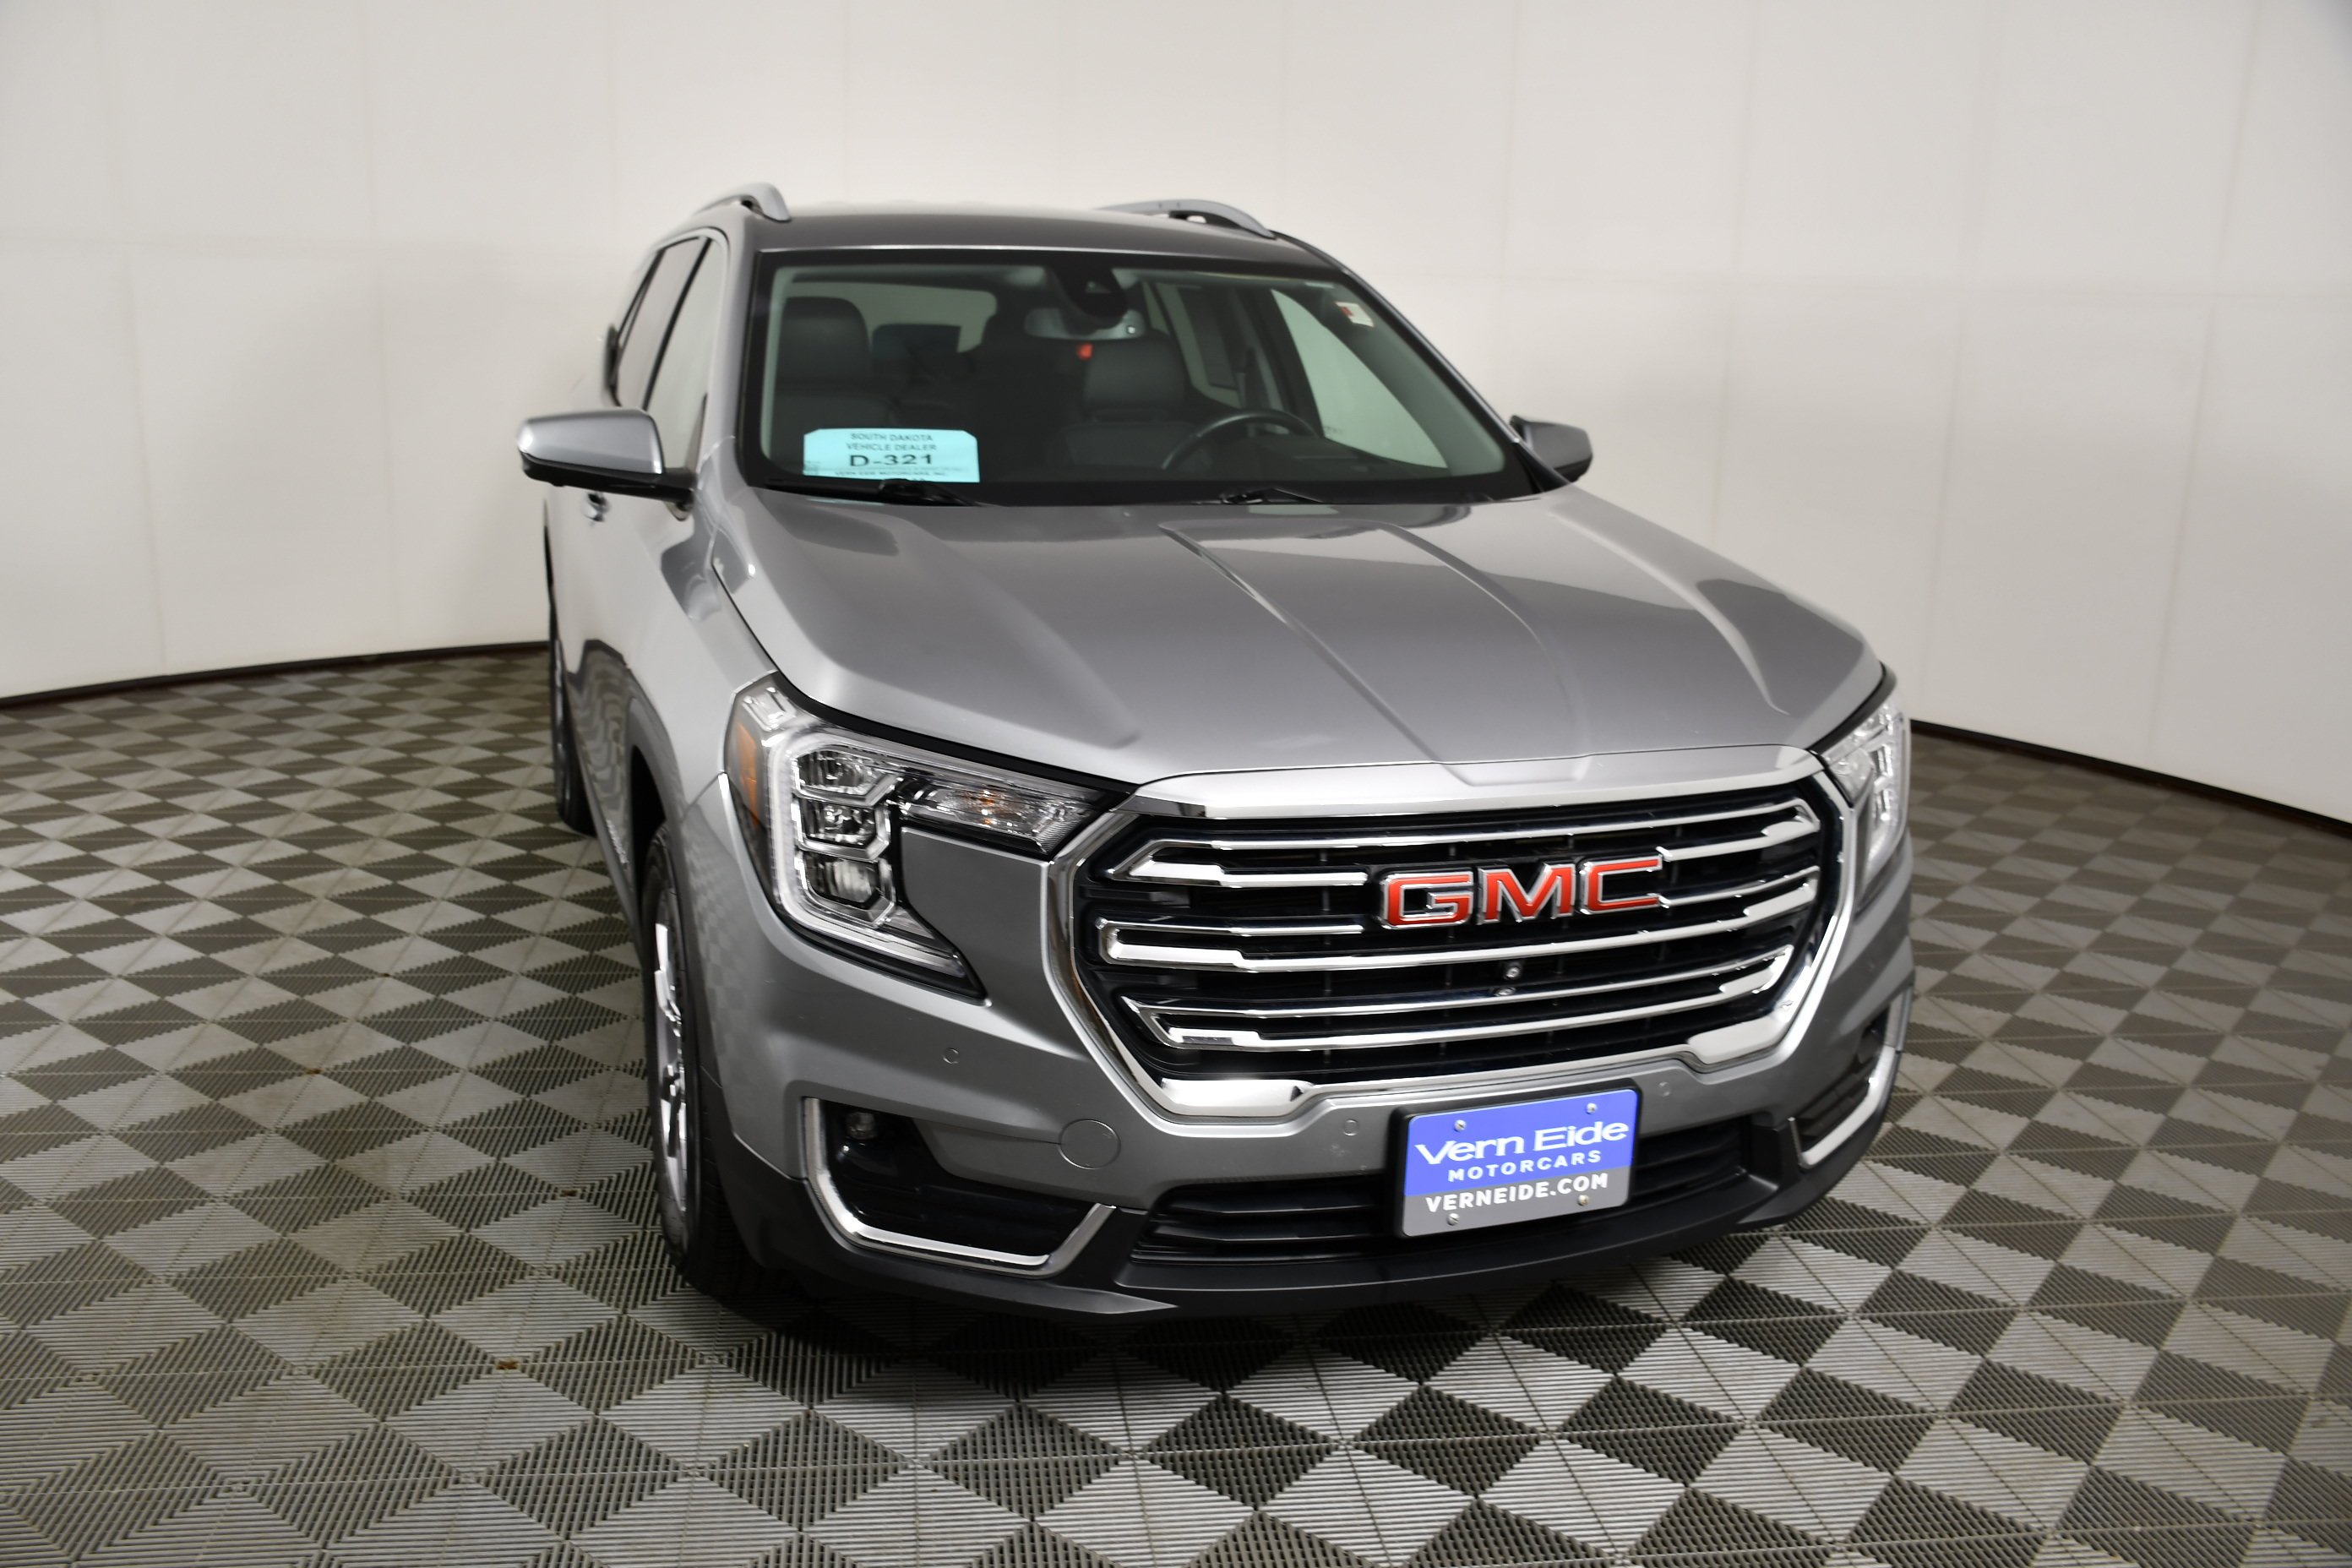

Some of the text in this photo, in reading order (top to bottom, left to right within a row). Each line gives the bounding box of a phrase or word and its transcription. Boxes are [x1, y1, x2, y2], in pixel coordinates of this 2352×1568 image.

[849, 455, 933, 466] D-321
[1381, 855, 1663, 929] GMC
[1414, 1121, 1630, 1165] Vern Eide
[1447, 1150, 1602, 1183] MOTORCARS
[1425, 1173, 1609, 1212] VERNEIDE.COM
